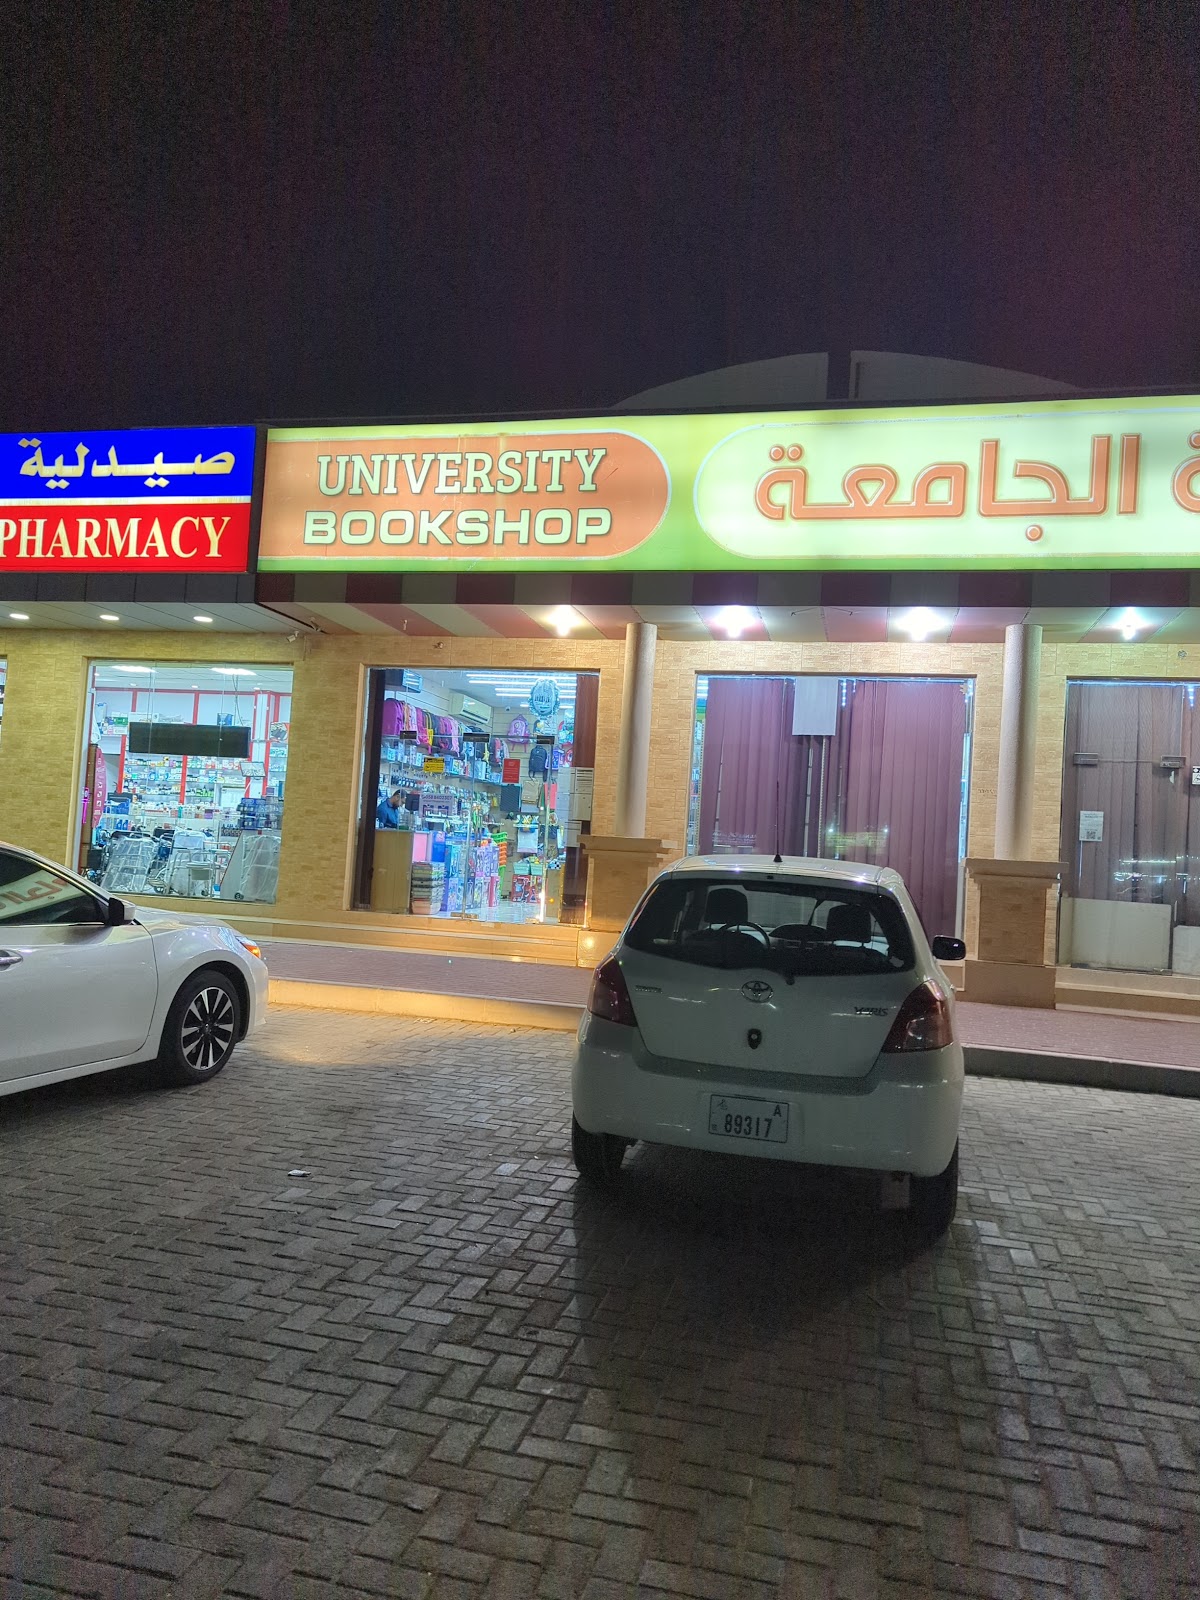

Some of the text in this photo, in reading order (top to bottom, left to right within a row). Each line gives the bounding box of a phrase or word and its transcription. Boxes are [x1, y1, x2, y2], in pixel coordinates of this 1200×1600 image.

[18, 437, 236, 490] صيدلية
[317, 448, 607, 496] UNIVERSITY
[754, 432, 1142, 542] الجامعة
[0, 516, 232, 559] PHARMACY
[303, 507, 613, 545] BOOKSHOP
[724, 1113, 773, 1138] 89317
[773, 1104, 782, 1118] A
